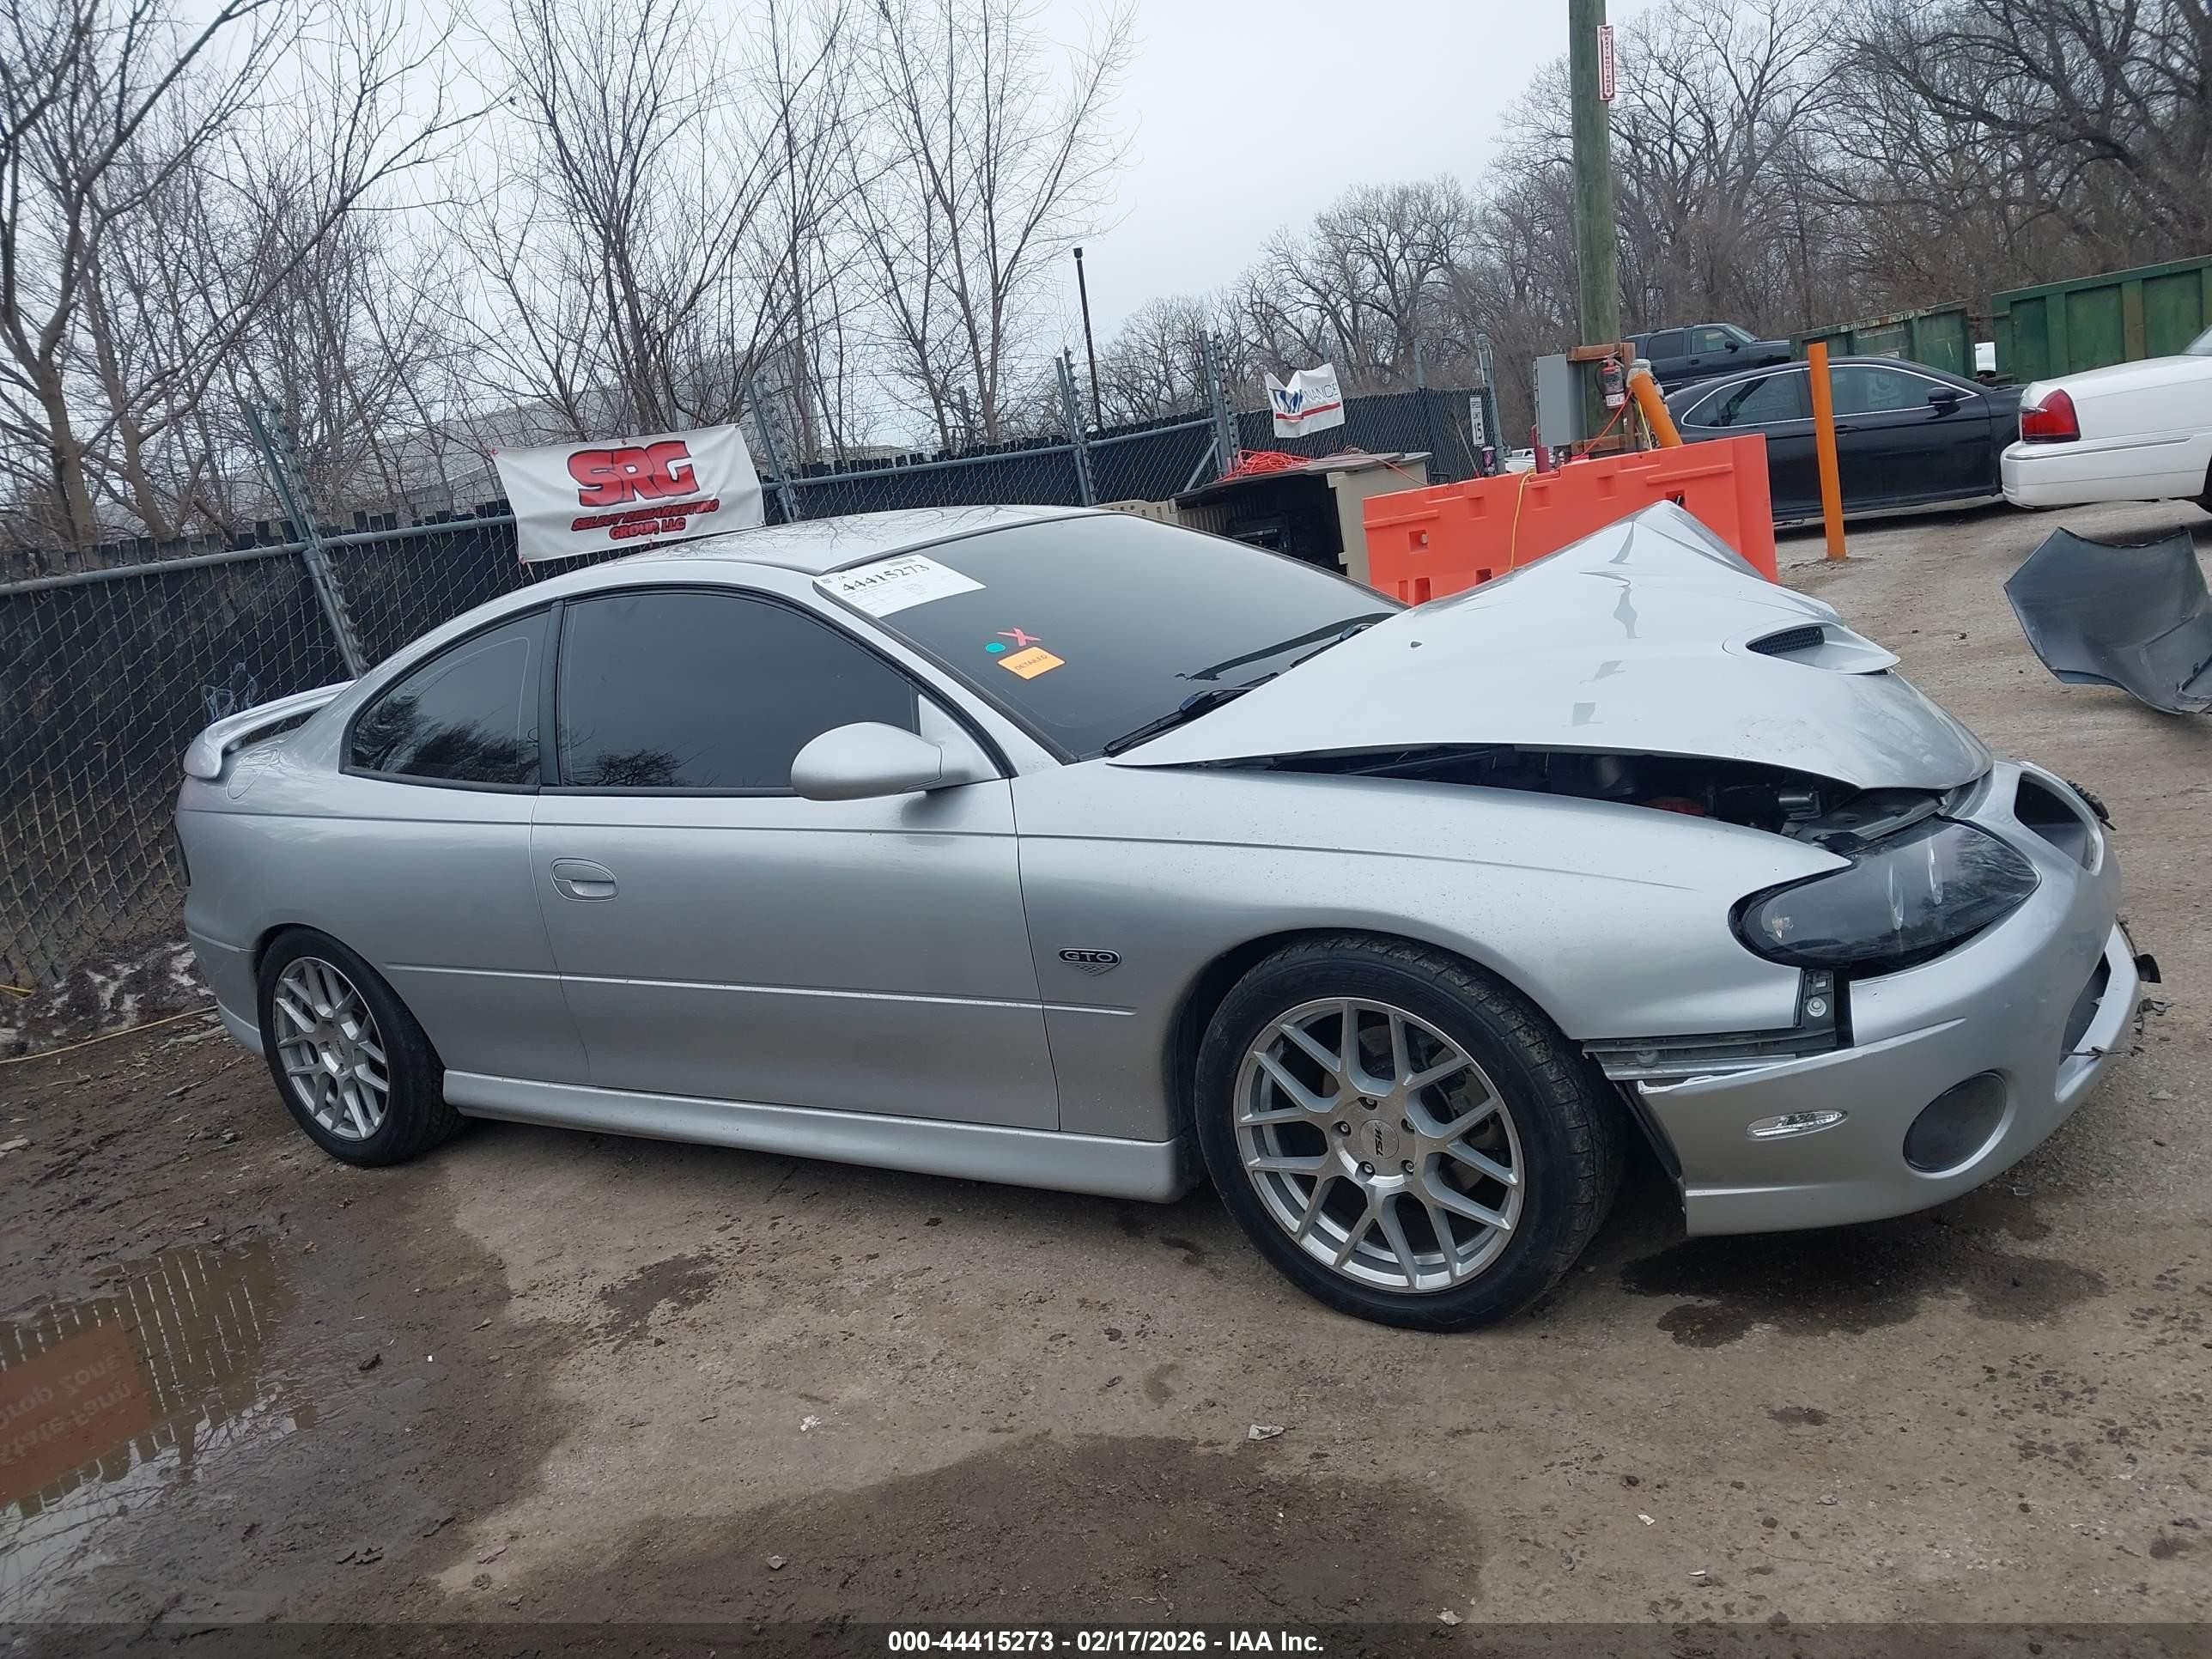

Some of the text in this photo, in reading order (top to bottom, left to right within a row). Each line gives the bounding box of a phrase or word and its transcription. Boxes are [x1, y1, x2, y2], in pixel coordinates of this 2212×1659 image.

[1302, 382, 1338, 404] INANCE
[1474, 422, 1483, 441] 15
[568, 440, 701, 507] SRG
[572, 500, 720, 532] SELECT REMARKETING
[609, 517, 687, 540] GROUP, LLC
[842, 563, 931, 592] 44415273
[1014, 653, 1048, 672] DETAILED
[1065, 951, 1114, 962] GTO
